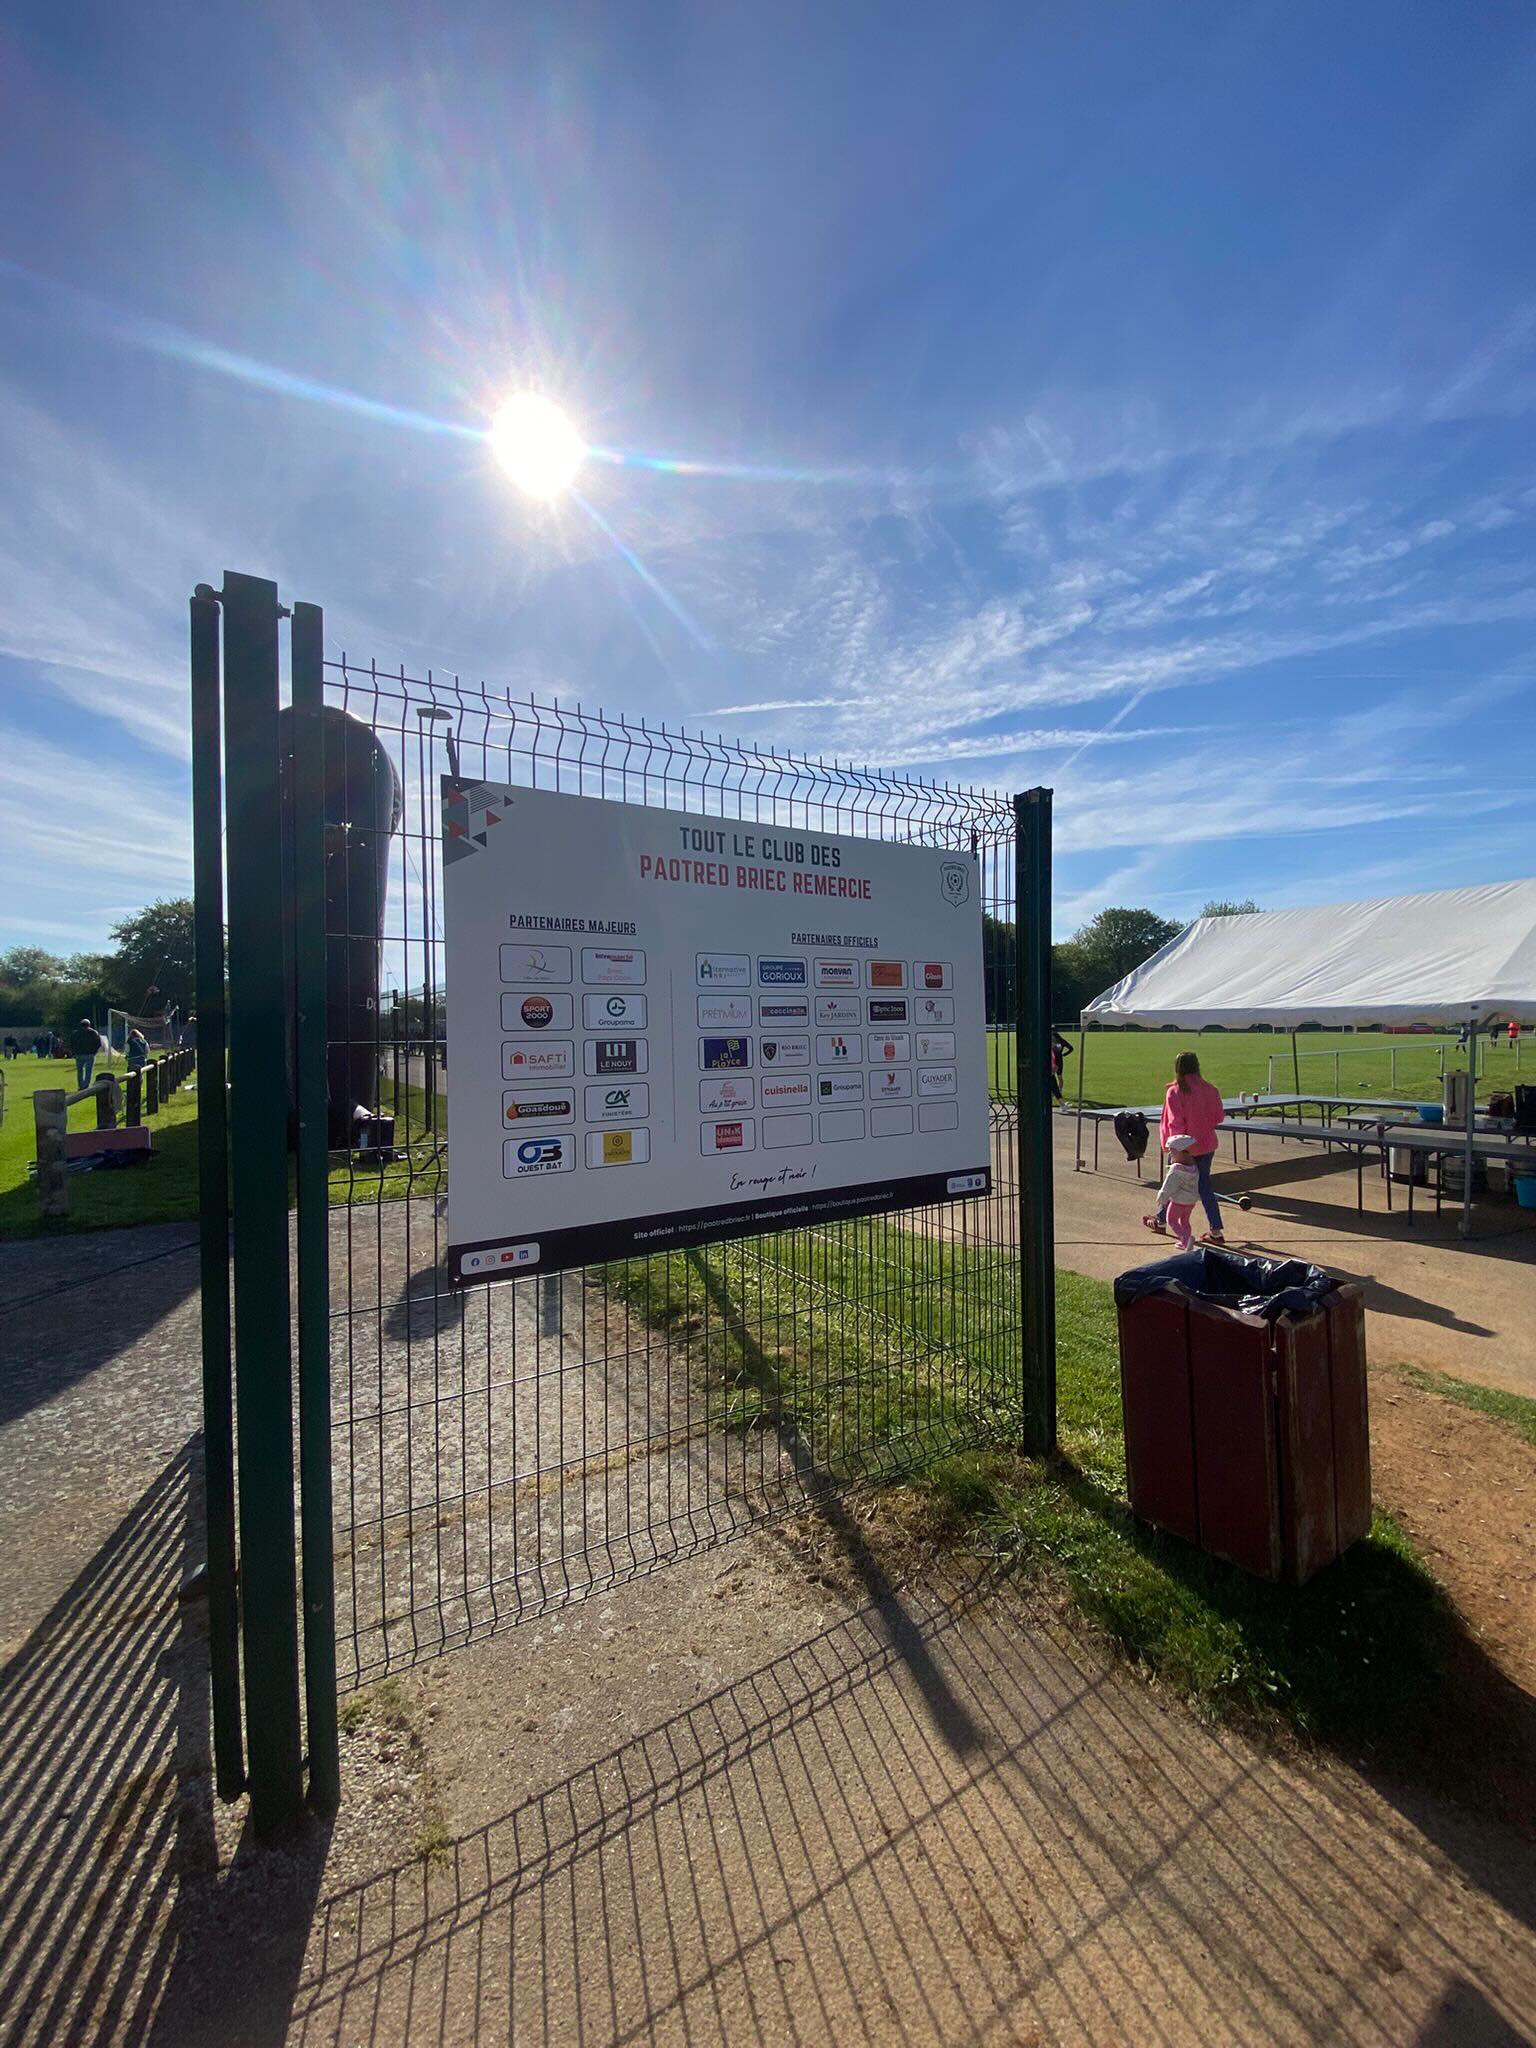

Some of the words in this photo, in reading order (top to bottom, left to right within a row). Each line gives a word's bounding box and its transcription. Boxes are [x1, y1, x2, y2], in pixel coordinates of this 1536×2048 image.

[680, 826, 726, 855] TOUT
[734, 834, 755, 858] LE
[762, 838, 805, 864] CLUB
[811, 845, 841, 868] DES
[639, 854, 729, 887] PAOTRED
[737, 865, 786, 892] BRIEC
[793, 871, 872, 900] REMERCIE
[509, 914, 585, 931] PARTENAIRES
[588, 919, 637, 935] MAJEURS
[791, 932, 841, 946] PARTENAIRES
[843, 936, 879, 948] OFFICIELS
[525, 1012, 548, 1020] 2000
[611, 1060, 632, 1068] NOUY
[764, 1083, 809, 1096] cuisinella
[833, 1083, 862, 1092] Groupama
[517, 1164, 545, 1173] OUEST
[545, 1161, 563, 1170] BAT
[730, 1172, 747, 1190] En
[748, 1176, 777, 1191] rouge
[777, 1166, 794, 1185] et
[633, 1231, 649, 1240] Site
[649, 1227, 675, 1238] officiel
[754, 1209, 783, 1220] Boutique
